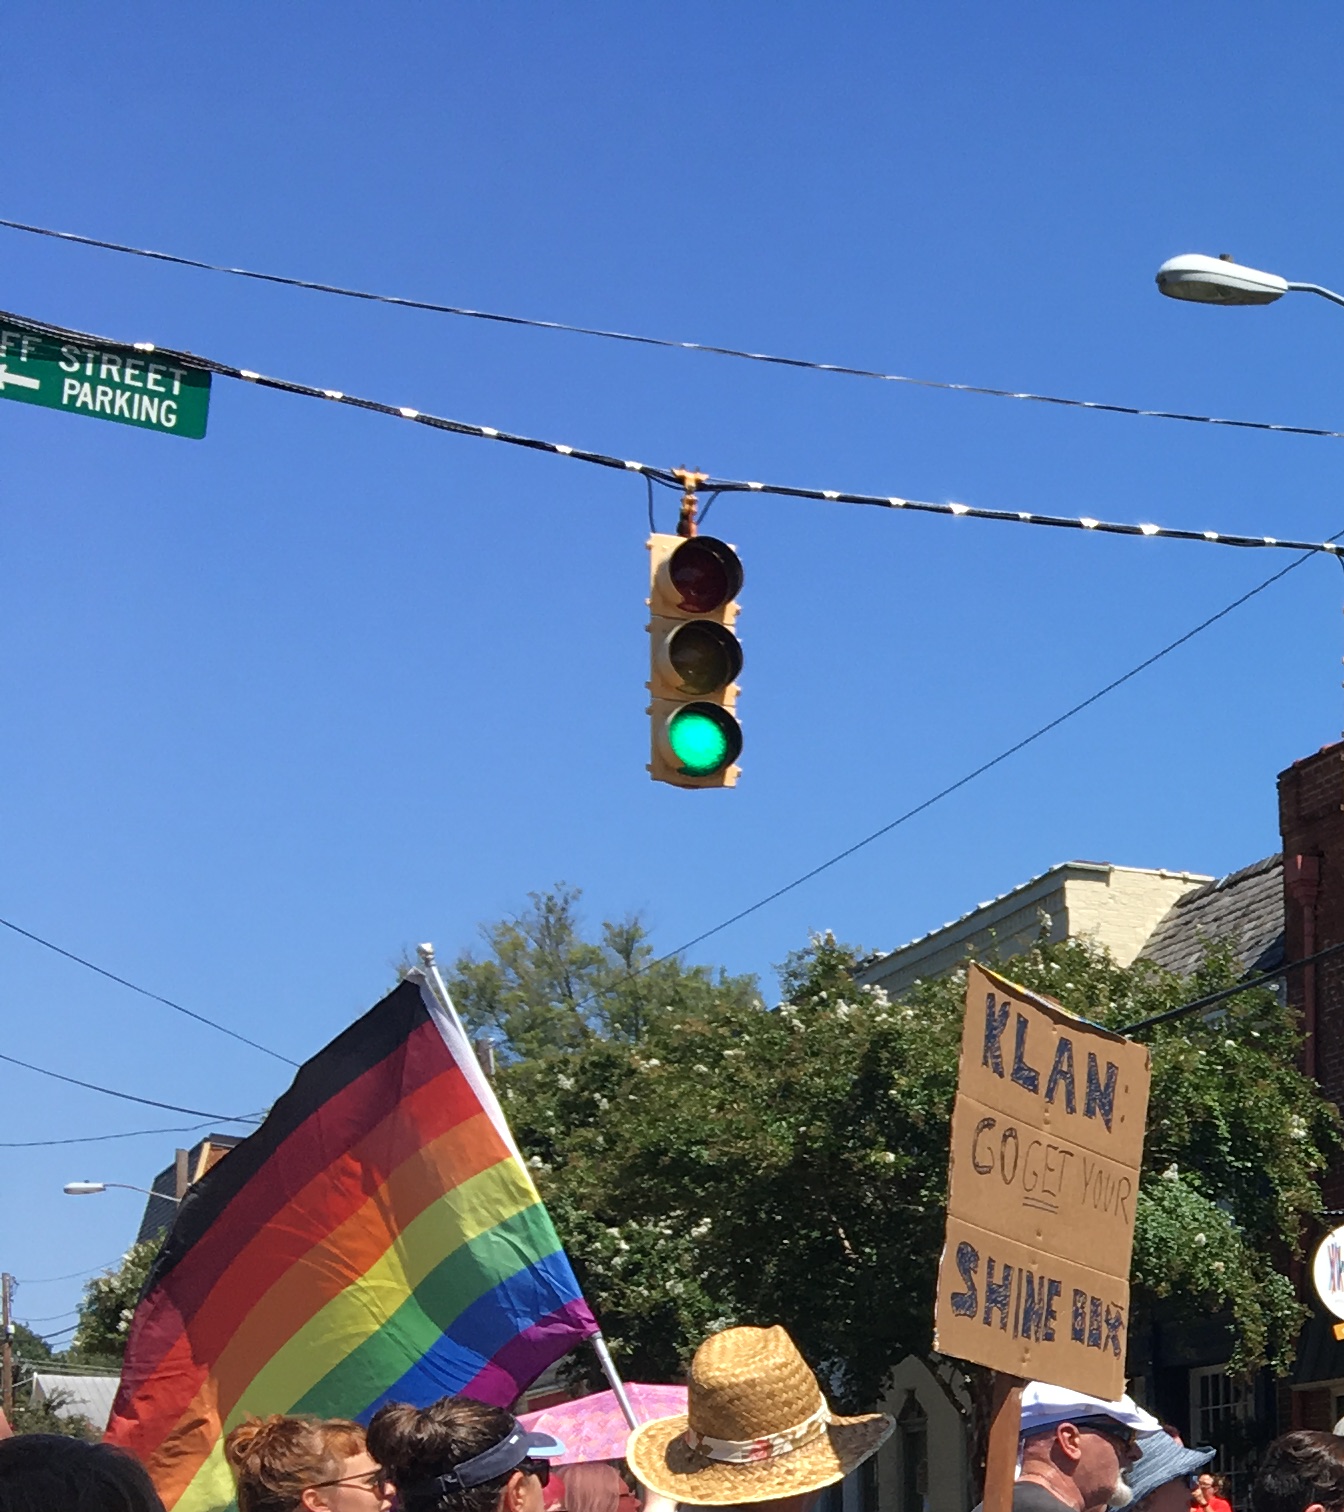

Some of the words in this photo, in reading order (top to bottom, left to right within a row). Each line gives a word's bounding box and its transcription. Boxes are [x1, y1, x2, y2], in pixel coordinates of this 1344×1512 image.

[58, 345, 188, 396] STREET
[62, 378, 178, 428] PARKING
[971, 1117, 1019, 1186] GO
[1023, 1139, 1074, 1198] GET
[1081, 1157, 1130, 1225] YOUR
[950, 1241, 1063, 1344] SHINE
[1071, 1288, 1126, 1359] BOX
